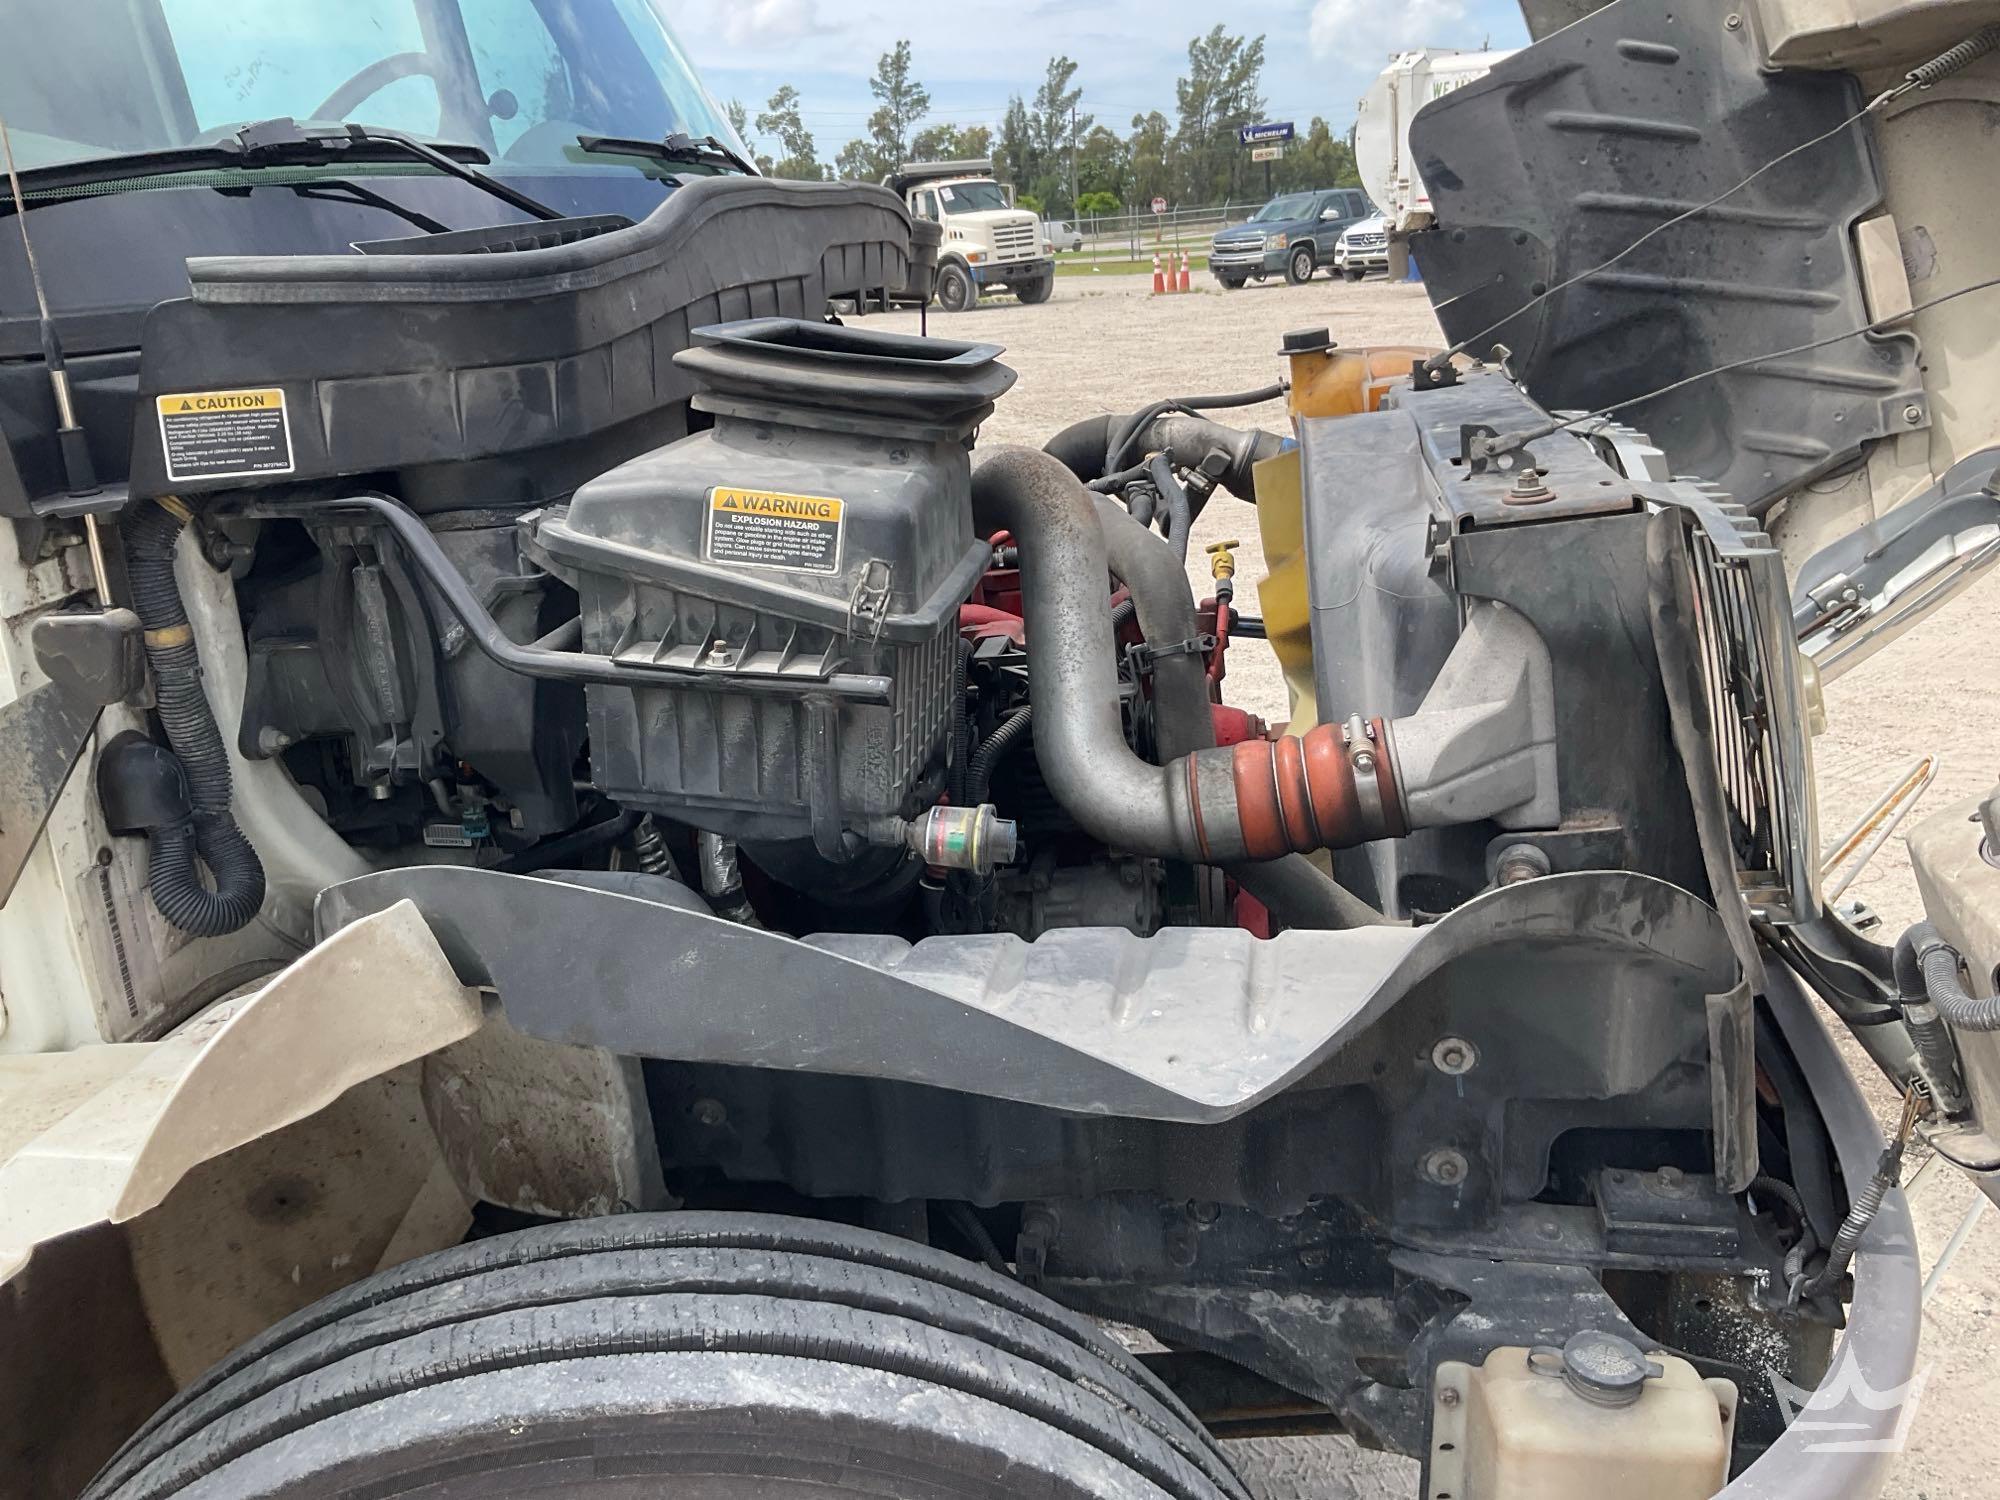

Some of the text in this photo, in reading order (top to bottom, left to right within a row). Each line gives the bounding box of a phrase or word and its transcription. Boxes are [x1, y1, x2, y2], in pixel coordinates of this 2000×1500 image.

[1254, 128, 1288, 138] MICHELIN
[196, 396, 264, 410] CAUTION
[742, 495, 830, 517] WARNING
[731, 515, 820, 531] EXPLOSION HAZARD
[801, 550, 822, 558] damage
